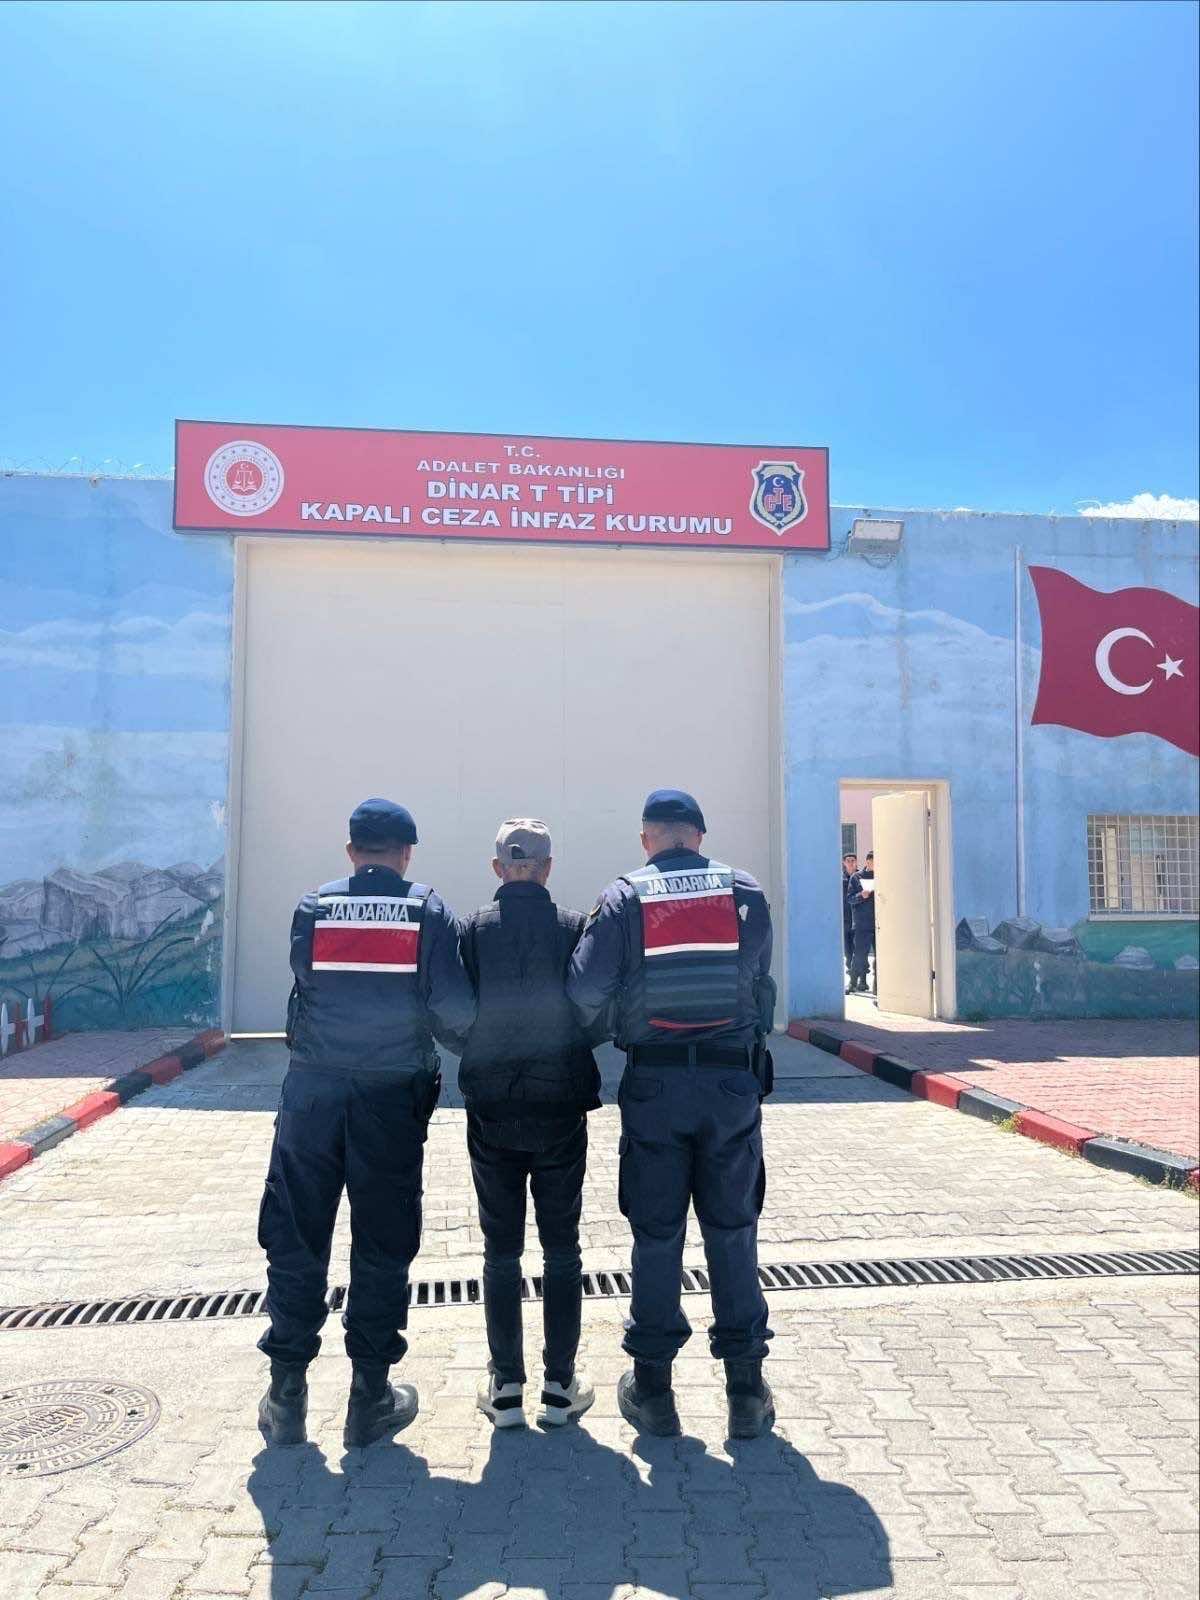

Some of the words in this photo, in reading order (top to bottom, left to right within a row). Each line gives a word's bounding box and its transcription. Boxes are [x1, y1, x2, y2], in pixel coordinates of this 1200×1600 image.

[503, 445, 541, 458] T.C.
[416, 459, 501, 474] ADALET
[508, 463, 625, 479] BAKANLIĞI
[427, 478, 520, 501] DİNAR
[529, 485, 548, 502] T
[557, 483, 614, 504] TİPİ
[300, 502, 410, 524] KAPALI
[421, 507, 501, 527] CEZA
[510, 506, 596, 531] İNFAZ
[605, 513, 733, 535] KURUMU
[646, 874, 723, 895] JANDARMA
[326, 902, 409, 922] JANDARMA
